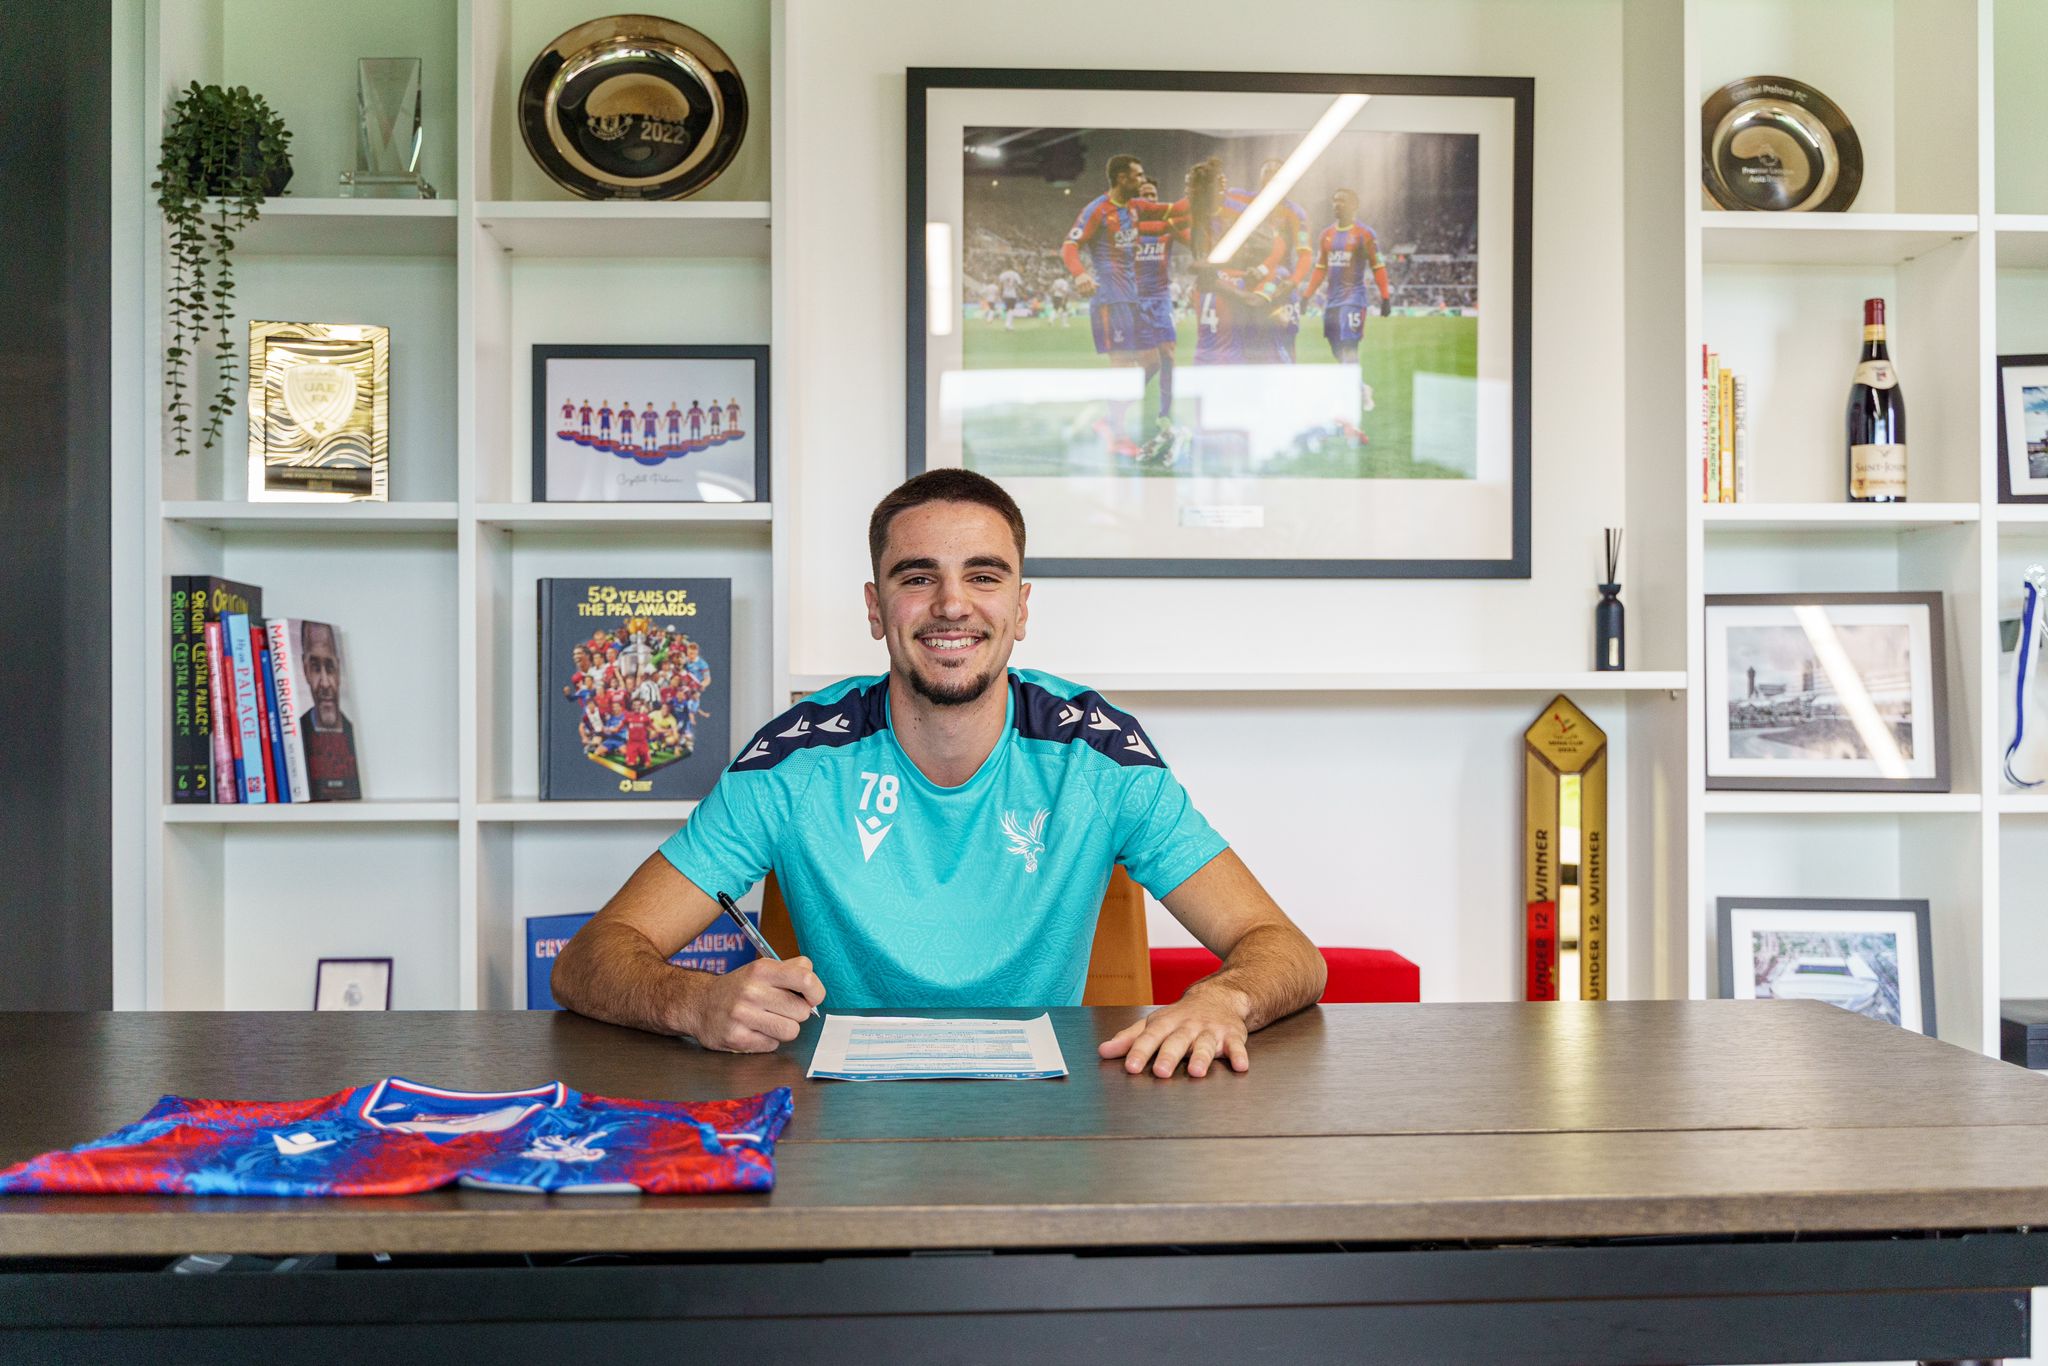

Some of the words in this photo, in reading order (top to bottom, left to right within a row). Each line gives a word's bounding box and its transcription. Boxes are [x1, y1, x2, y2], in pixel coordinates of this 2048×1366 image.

[640, 121, 686, 144] 2022
[1347, 311, 1362, 328] 15
[304, 381, 337, 393] UAE
[172, 590, 187, 634] ORIGIN
[191, 590, 207, 634] ORIGIN
[577, 603, 606, 616] THE
[606, 603, 633, 616] PFA
[634, 602, 697, 616] AWARDS
[588, 586, 618, 604] 50
[619, 590, 664, 604] YEARS
[665, 590, 688, 603] OF
[173, 642, 189, 687] CRYSTAL
[192, 642, 208, 686] CRYSTAL
[270, 624, 288, 672] MARK
[176, 688, 190, 725] PALACE
[195, 687, 209, 725] PALACE
[237, 666, 258, 739] PALACE
[277, 677, 297, 736] BRIGHT
[178, 775, 188, 790] 6
[196, 774, 207, 790] 5
[859, 771, 900, 814] 78
[1535, 829, 1549, 903] WINNER
[1589, 831, 1600, 906] WINNER
[1535, 912, 1549, 929] 12
[1589, 914, 1600, 932] 12
[535, 938, 571, 959] CRY
[680, 933, 746, 953] ADEMY
[1535, 938, 1549, 998] UNDER
[1589, 940, 1600, 1000] UNDER
